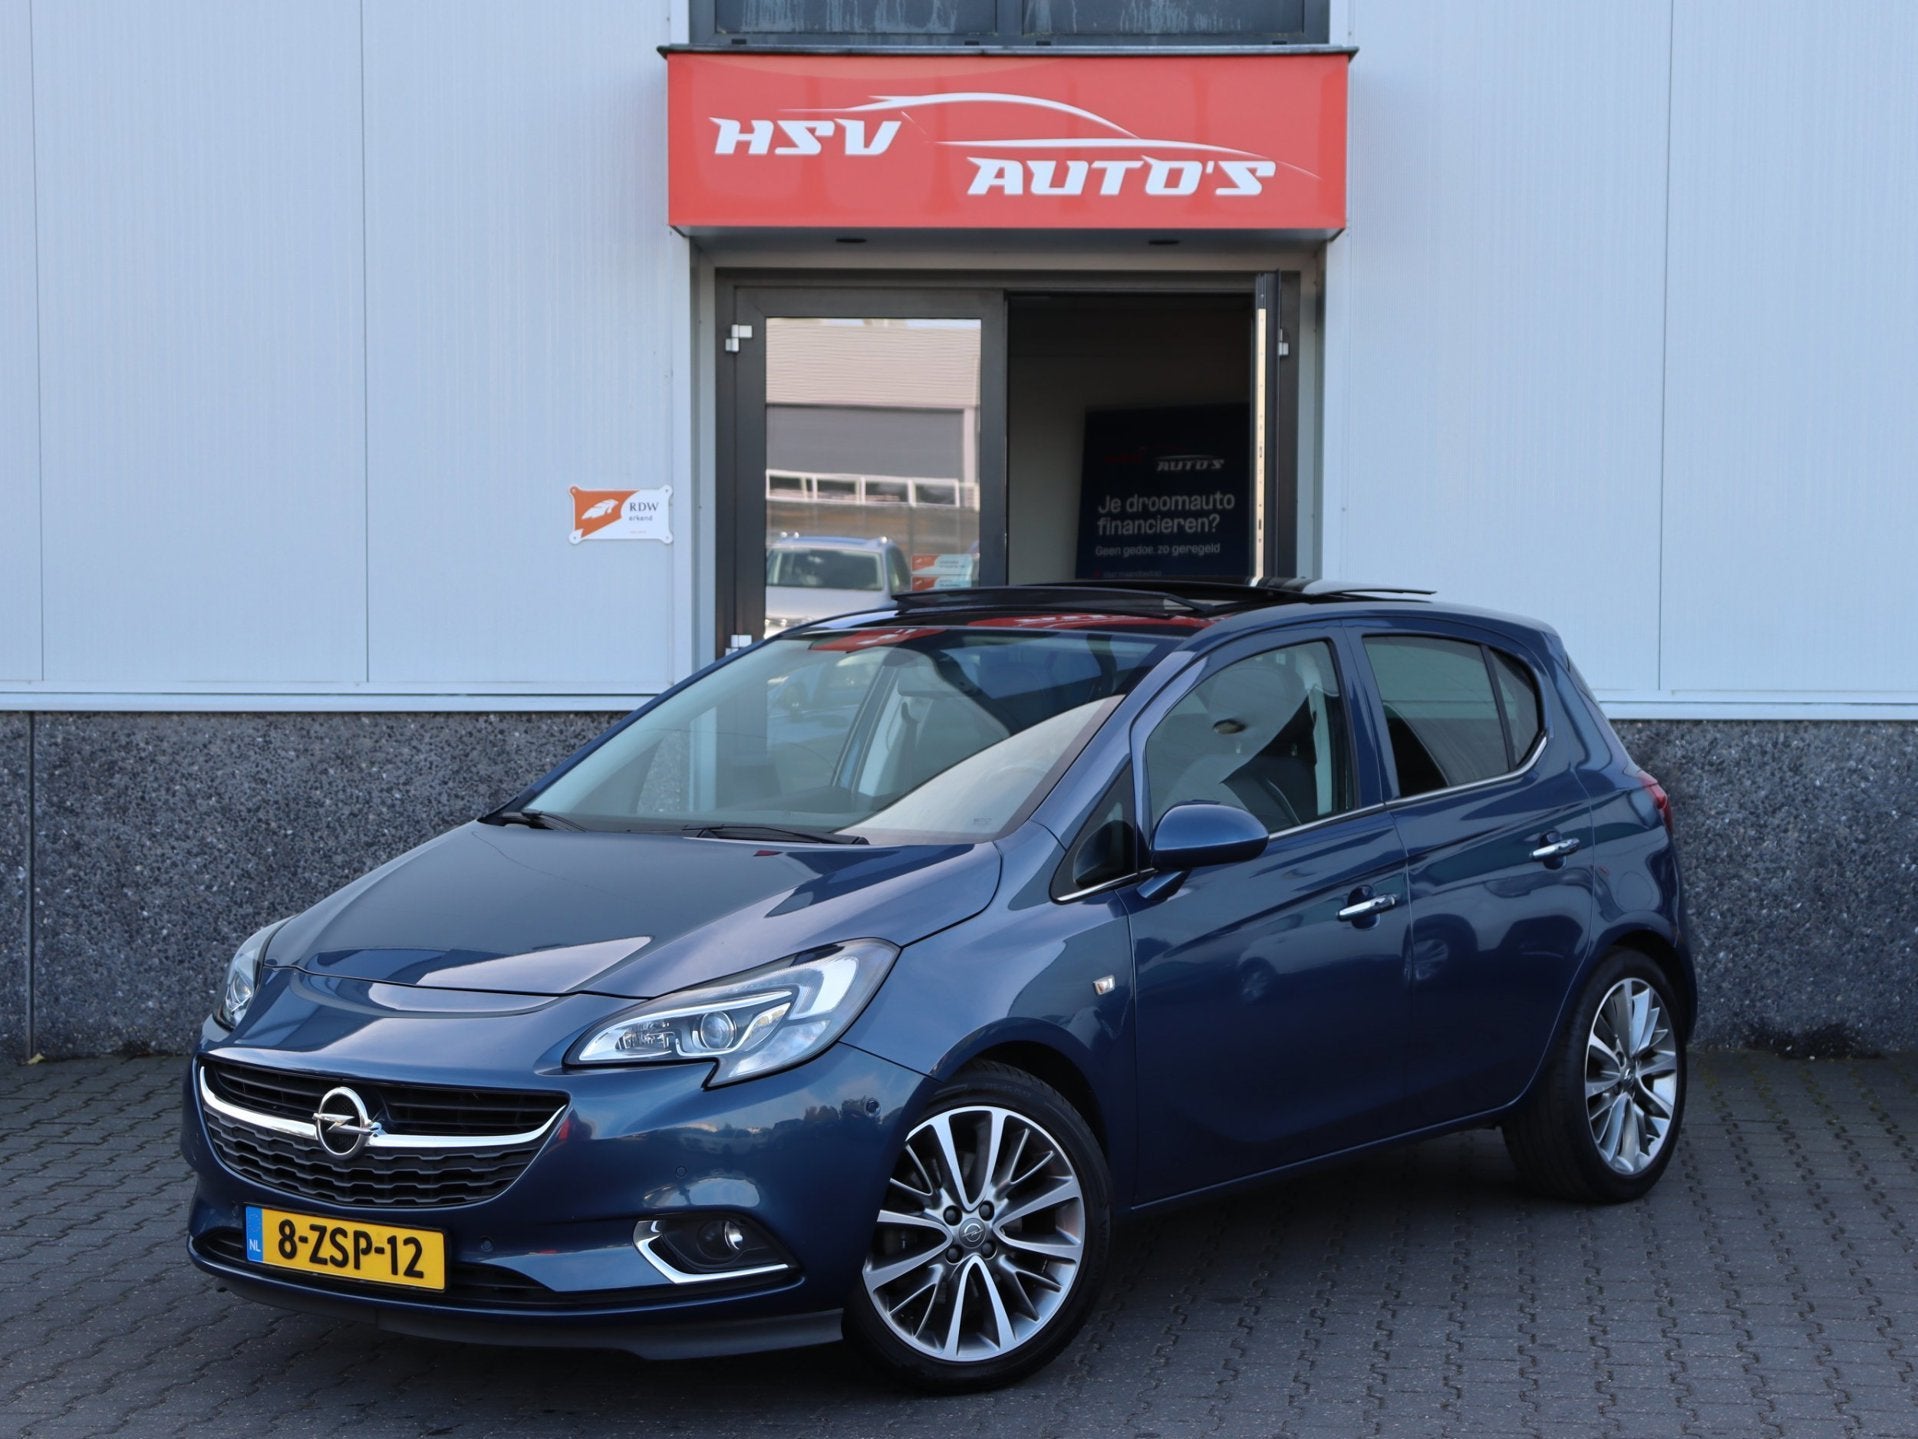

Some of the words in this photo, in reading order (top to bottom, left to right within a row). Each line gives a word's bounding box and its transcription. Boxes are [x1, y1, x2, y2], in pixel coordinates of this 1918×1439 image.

[708, 117, 902, 156] HSV
[967, 156, 1276, 196] AUTO'S
[629, 502, 659, 512] RDW
[1098, 495, 1121, 513] Je
[1126, 491, 1235, 512] droomauto
[1097, 514, 1220, 536] financieren?
[1095, 546, 1121, 556] Geen
[1157, 545, 1170, 555] zo
[1172, 543, 1220, 558] geregeld
[249, 1239, 261, 1252] NL
[278, 1219, 424, 1279] 8-ZSP-12
